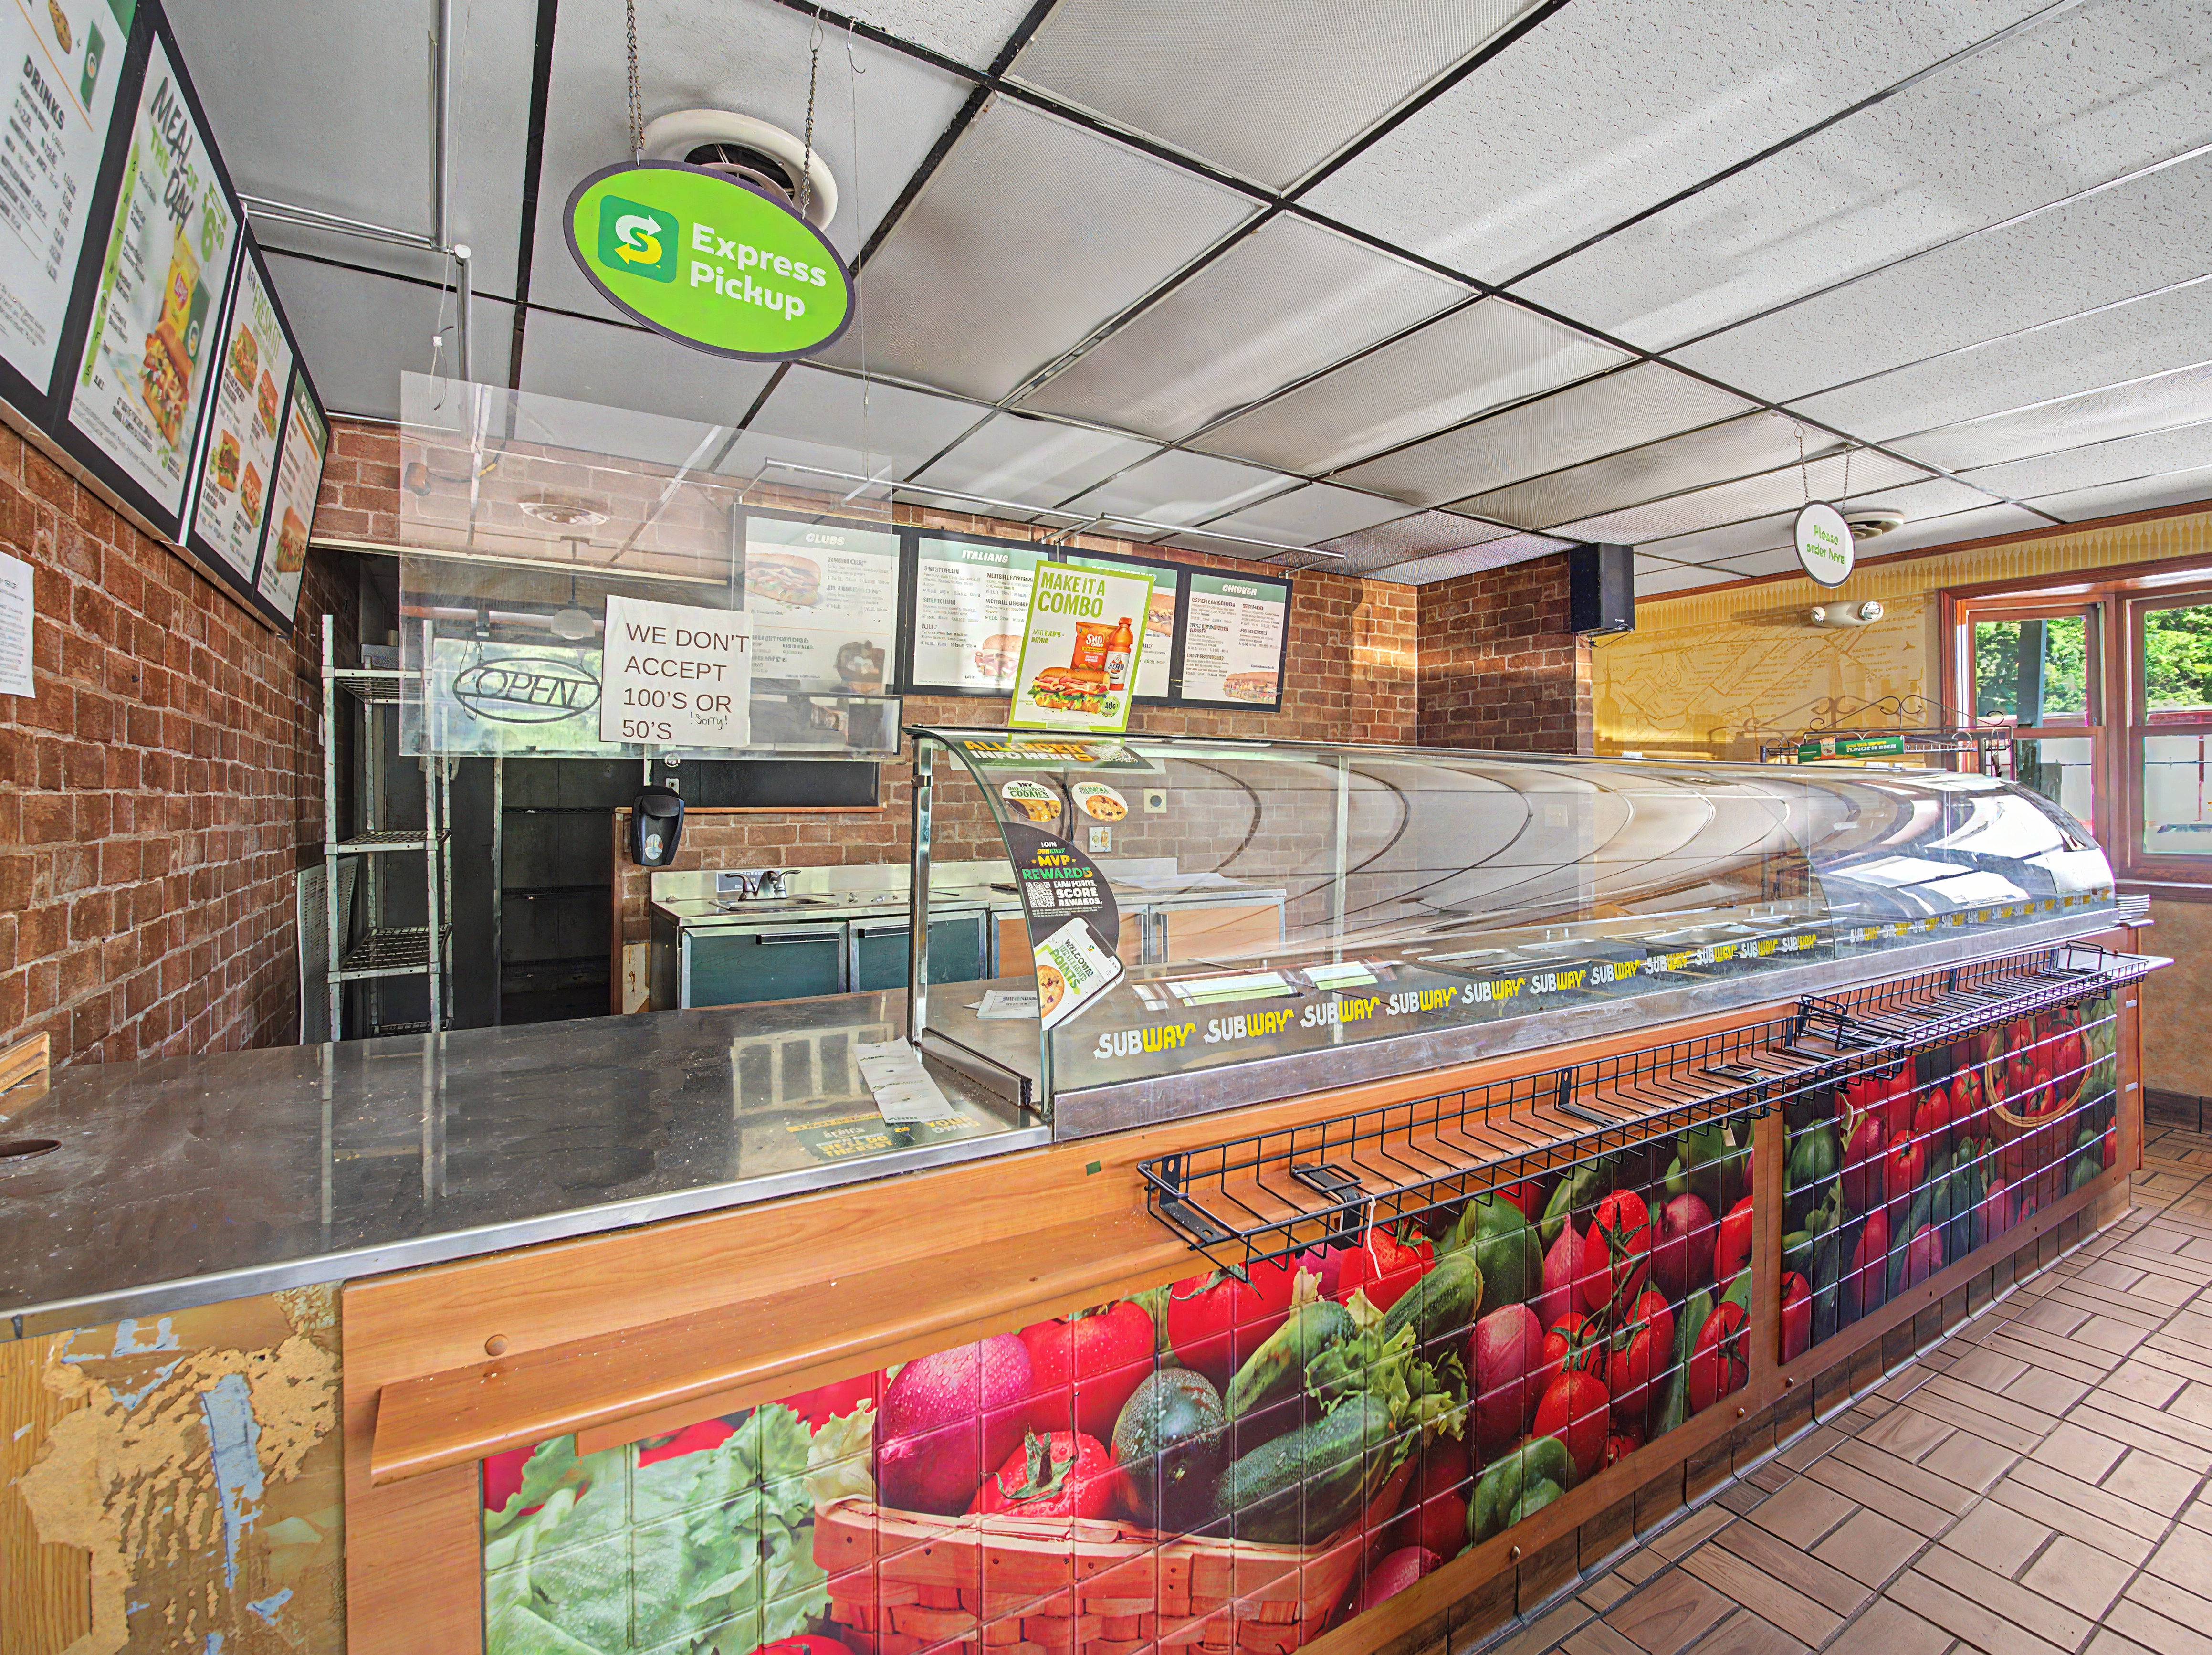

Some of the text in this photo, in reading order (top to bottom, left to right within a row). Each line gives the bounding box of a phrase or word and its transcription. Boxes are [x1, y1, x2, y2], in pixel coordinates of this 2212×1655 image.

[23, 54, 65, 130] DRINKS
[151, 77, 193, 175] MEAL
[164, 167, 194, 240] DAY
[692, 222, 826, 287] Express
[690, 260, 805, 320] Pickup
[806, 533, 845, 546] CLUBS
[962, 550, 1009, 563] ITALIANS
[1040, 572, 1081, 592] MAKE
[1082, 578, 1096, 594] IT
[1096, 580, 1105, 596] A
[1038, 590, 1103, 618] COMBO
[626, 623, 749, 652] WE DON'T
[624, 656, 727, 681] ACCEPT
[475, 668, 580, 708] OPEN
[623, 688, 732, 713] 100'S OR
[622, 719, 672, 740] 50'S
[970, 750, 1022, 759] INFO
[1022, 866, 1093, 880] REWARDS
[1037, 855, 1070, 867] MVP
[1056, 887, 1099, 899] SCORE
[1050, 948, 1081, 989] POINTS
[1093, 1023, 1196, 1060] SUBWAY
[1203, 1009, 1294, 1044] SUBWAY
[1300, 996, 1380, 1029] SUBWAY
[1385, 986, 1457, 1016] SUBWAY
[1461, 977, 1525, 1004] SUBWAY
[1529, 969, 1586, 994] SUBWAY
[1590, 959, 1640, 985] SUBWAY
